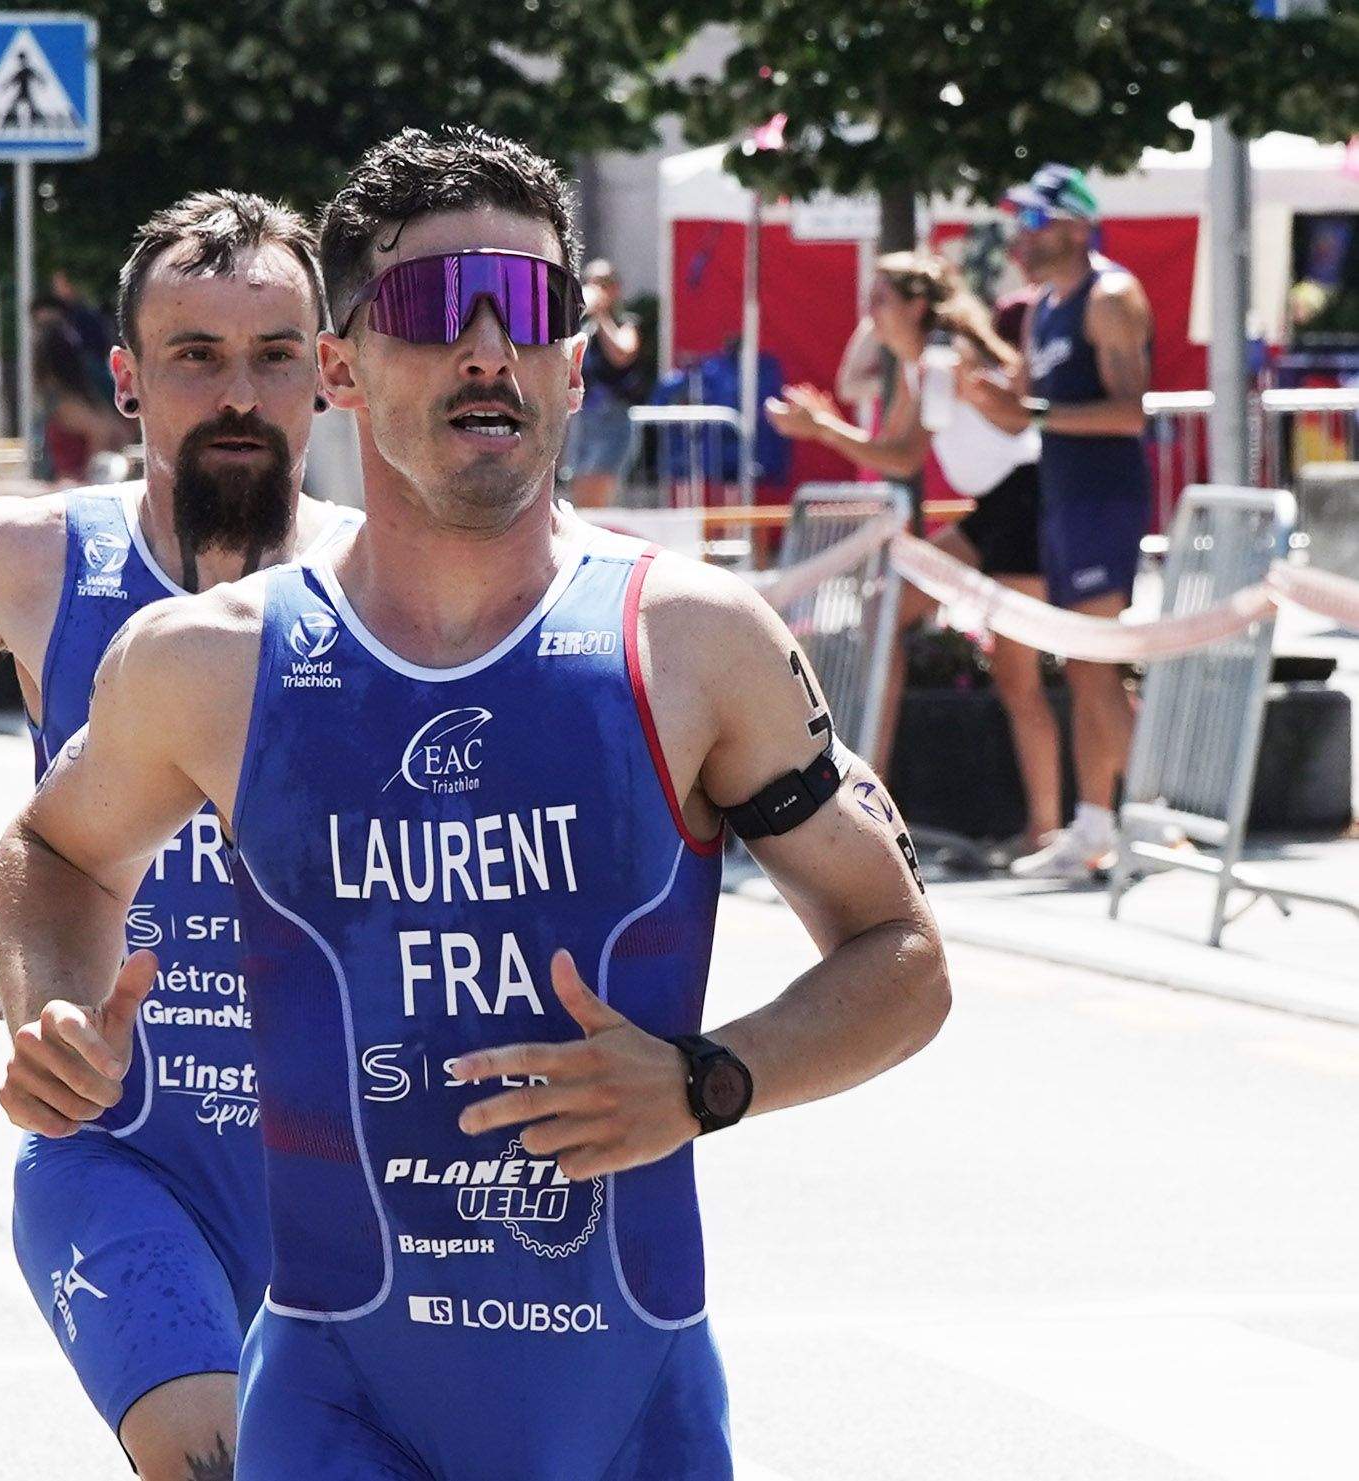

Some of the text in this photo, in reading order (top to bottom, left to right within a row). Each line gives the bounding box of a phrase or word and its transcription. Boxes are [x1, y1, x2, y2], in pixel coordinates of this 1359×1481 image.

[77, 585, 128, 600] Triathlon
[86, 574, 122, 588] World
[291, 661, 333, 675] World
[281, 674, 342, 689] Triathlon
[432, 776, 480, 794] Triathlon
[154, 813, 235, 886] FR
[329, 804, 578, 903] LAURENT
[398, 930, 545, 1017] FRA
[158, 1054, 259, 1093] L'inst
[398, 1235, 495, 1259] Bayeux
[461, 1299, 609, 1333] LOUBSOL
